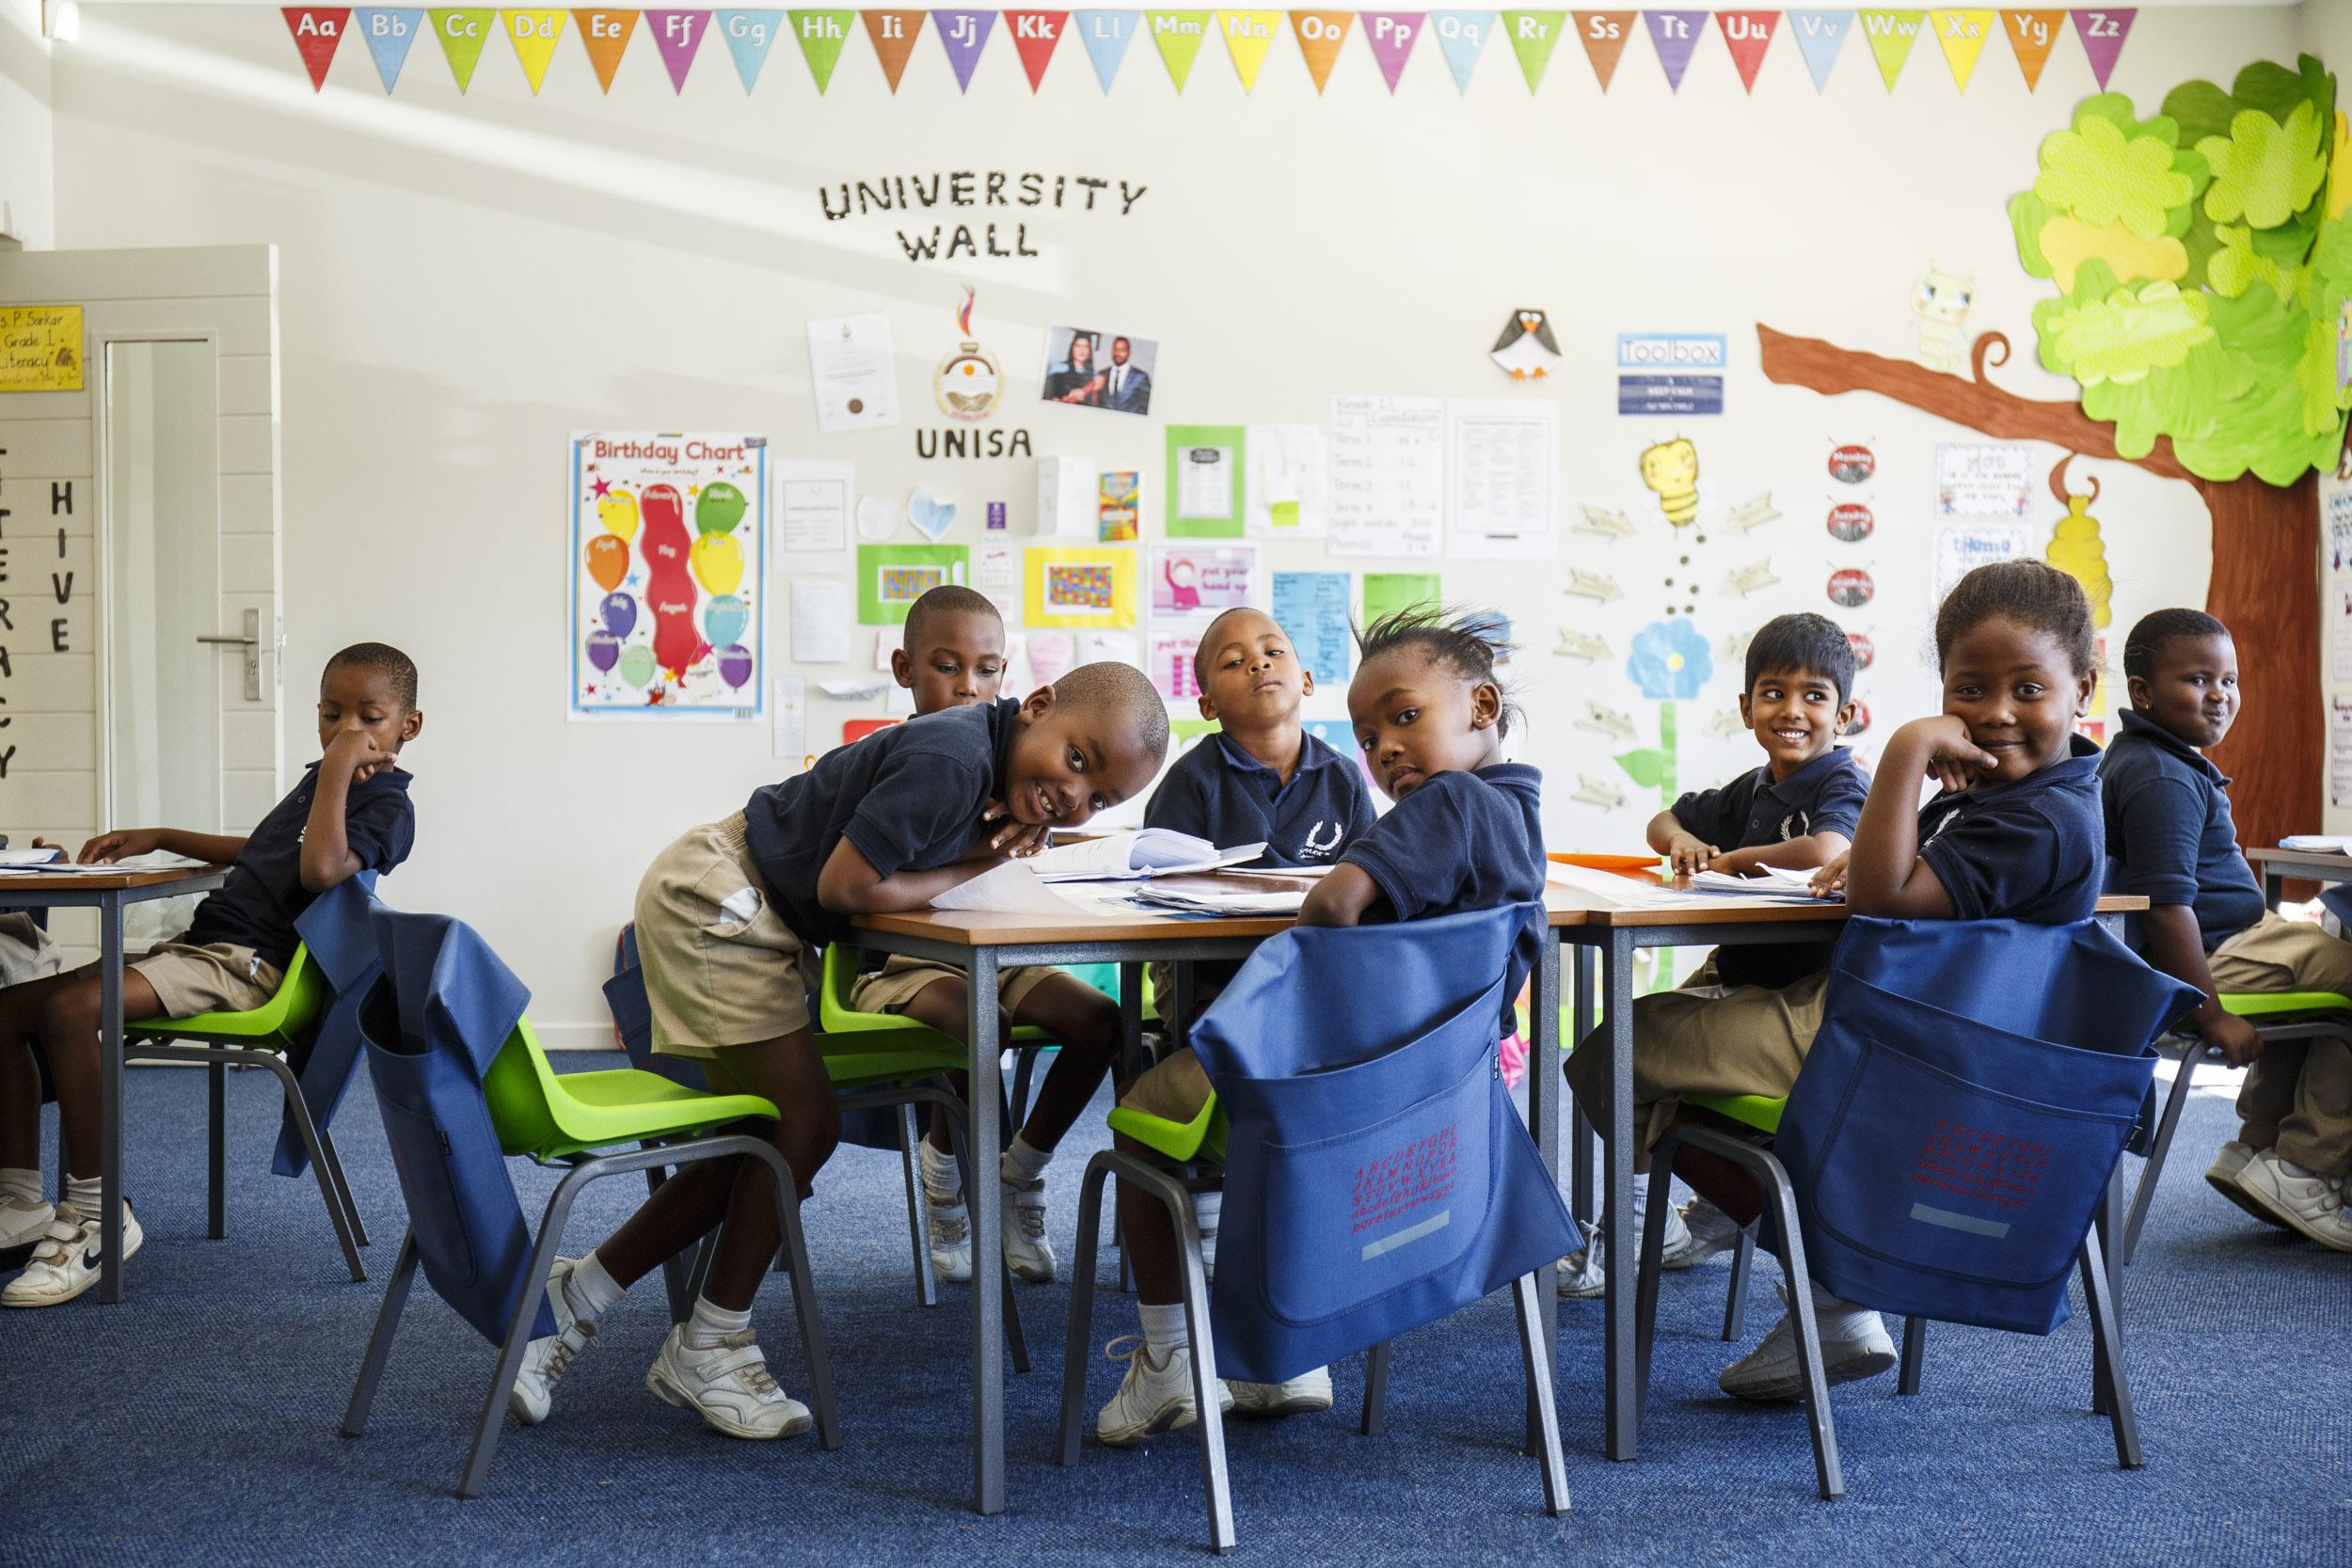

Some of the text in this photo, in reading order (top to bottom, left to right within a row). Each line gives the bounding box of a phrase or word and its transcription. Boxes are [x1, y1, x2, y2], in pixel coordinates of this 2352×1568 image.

[296, 13, 2120, 48] Aa Bb Cc Dd Ee Ff Gg Hh Ii Jj Kk Ll Mm Nn Oo Pp Qq Rr Ss Tt Uu Vv Ww Xx Yy Zz
[818, 170, 1148, 221] UNIVERSITY
[897, 222, 1039, 262] WALL
[4, 331, 40, 348] Grade
[1623, 339, 1719, 362] Toolbox
[0, 351, 49, 377] iteracy
[595, 440, 745, 465] Birthday Chart
[915, 428, 1033, 459] UNISA
[51, 481, 73, 653] HIVE
[1201, 568, 1248, 579] put your
[1203, 582, 1248, 594] hand up
[1158, 640, 1176, 650] put
